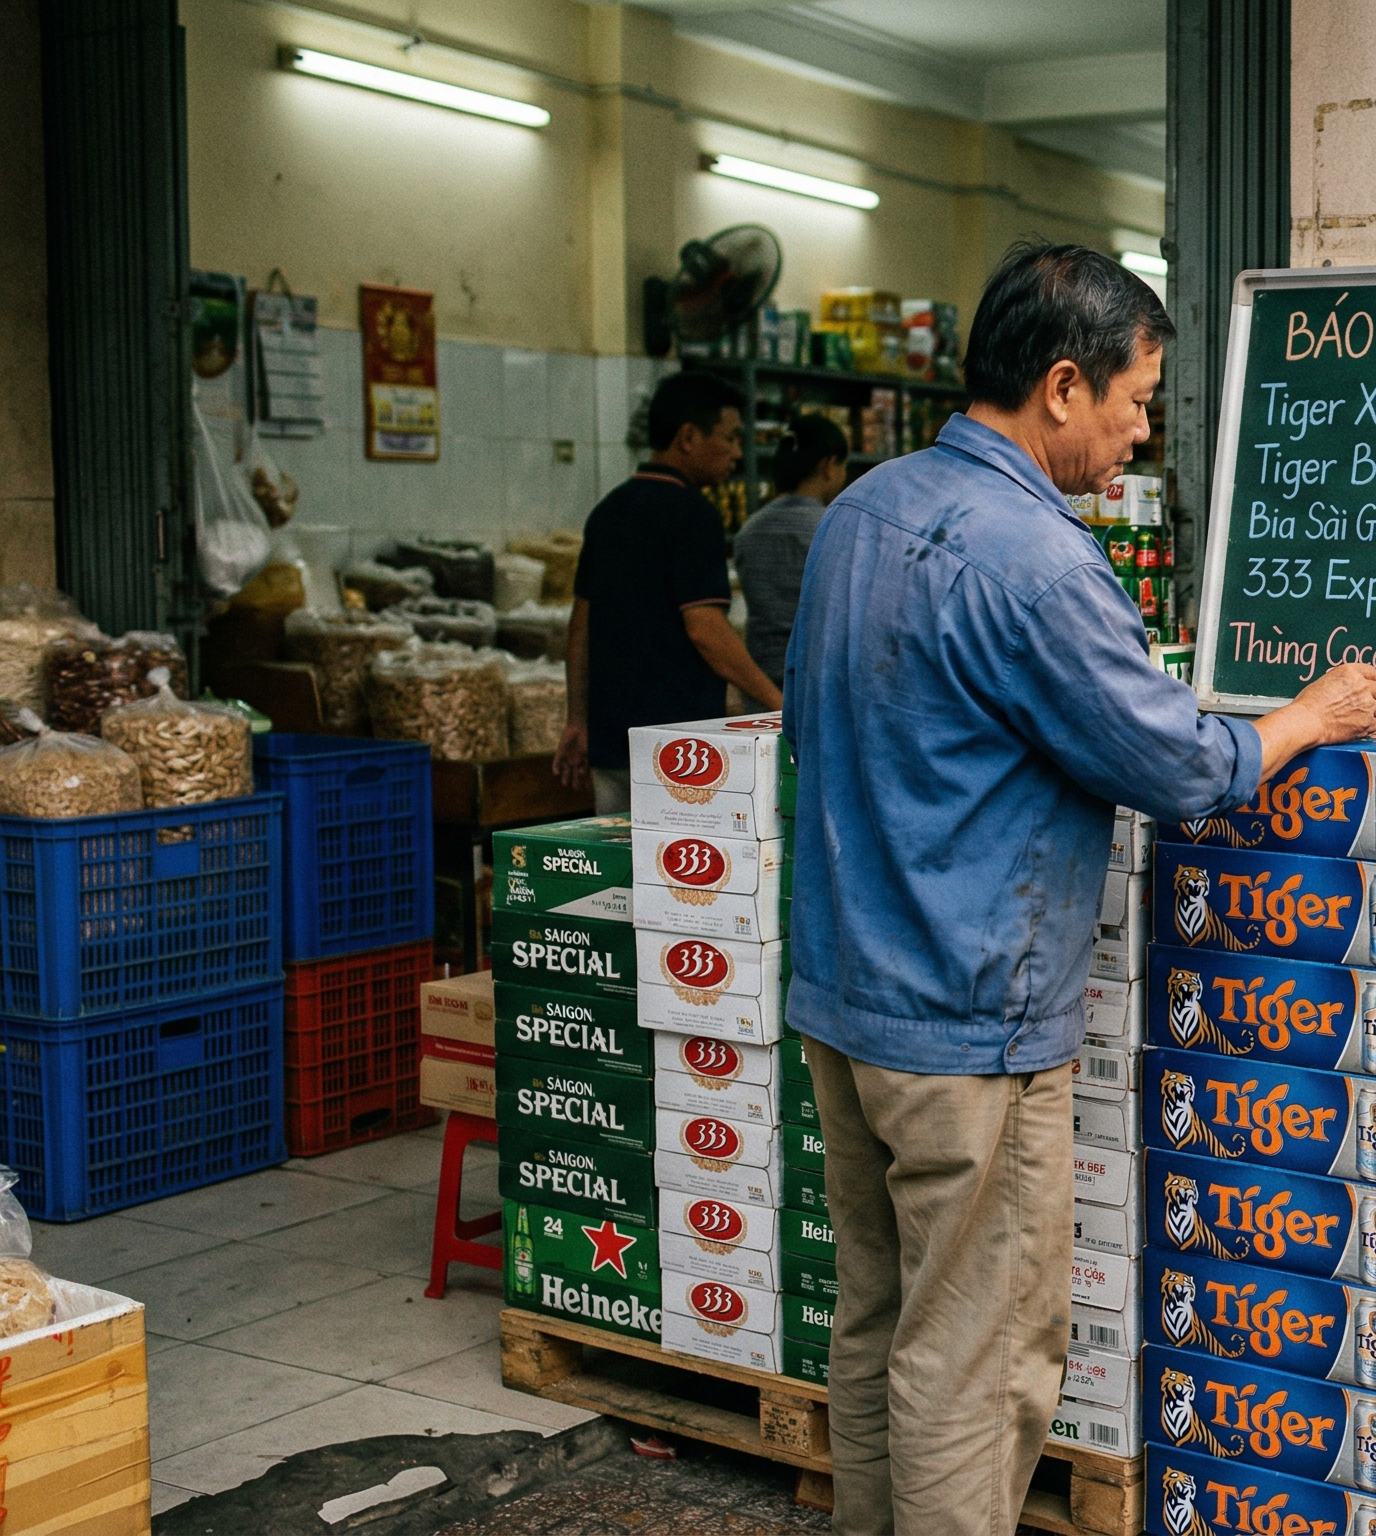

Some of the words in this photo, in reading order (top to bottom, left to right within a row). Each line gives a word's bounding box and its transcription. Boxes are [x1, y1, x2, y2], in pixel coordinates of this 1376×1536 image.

[1285, 292, 1374, 361] BÁO
[1261, 382, 1345, 440] Tiger
[1254, 443, 1337, 499] Tiger
[1248, 501, 1296, 540] Bia
[1305, 501, 1347, 541] Sài
[1243, 558, 1313, 599] 333
[1229, 621, 1318, 681] Thùng
[669, 738, 712, 778] 333
[1236, 767, 1358, 841] iger
[543, 855, 602, 875] SPECIAL
[673, 843, 712, 877] 333
[1218, 871, 1352, 947] Tiger
[544, 928, 590, 946] SAIGON
[512, 940, 620, 979] SPECIAL
[674, 943, 715, 978] 333
[516, 1014, 624, 1055] SPECIAL
[1212, 976, 1344, 1052] Tiger
[697, 1041, 727, 1069] 333
[517, 1088, 625, 1131] SPECIAL
[1205, 1079, 1337, 1156] Tiger
[697, 1122, 727, 1150] 333
[548, 1150, 594, 1171] SAIGON
[519, 1161, 626, 1206] SPECIAL
[543, 1216, 563, 1235] 24
[700, 1204, 731, 1232] 333
[1208, 1182, 1340, 1260] Tiger
[700, 1285, 733, 1314] 333
[1205, 1280, 1336, 1358] Tiger
[1205, 1380, 1336, 1458] Tiger
